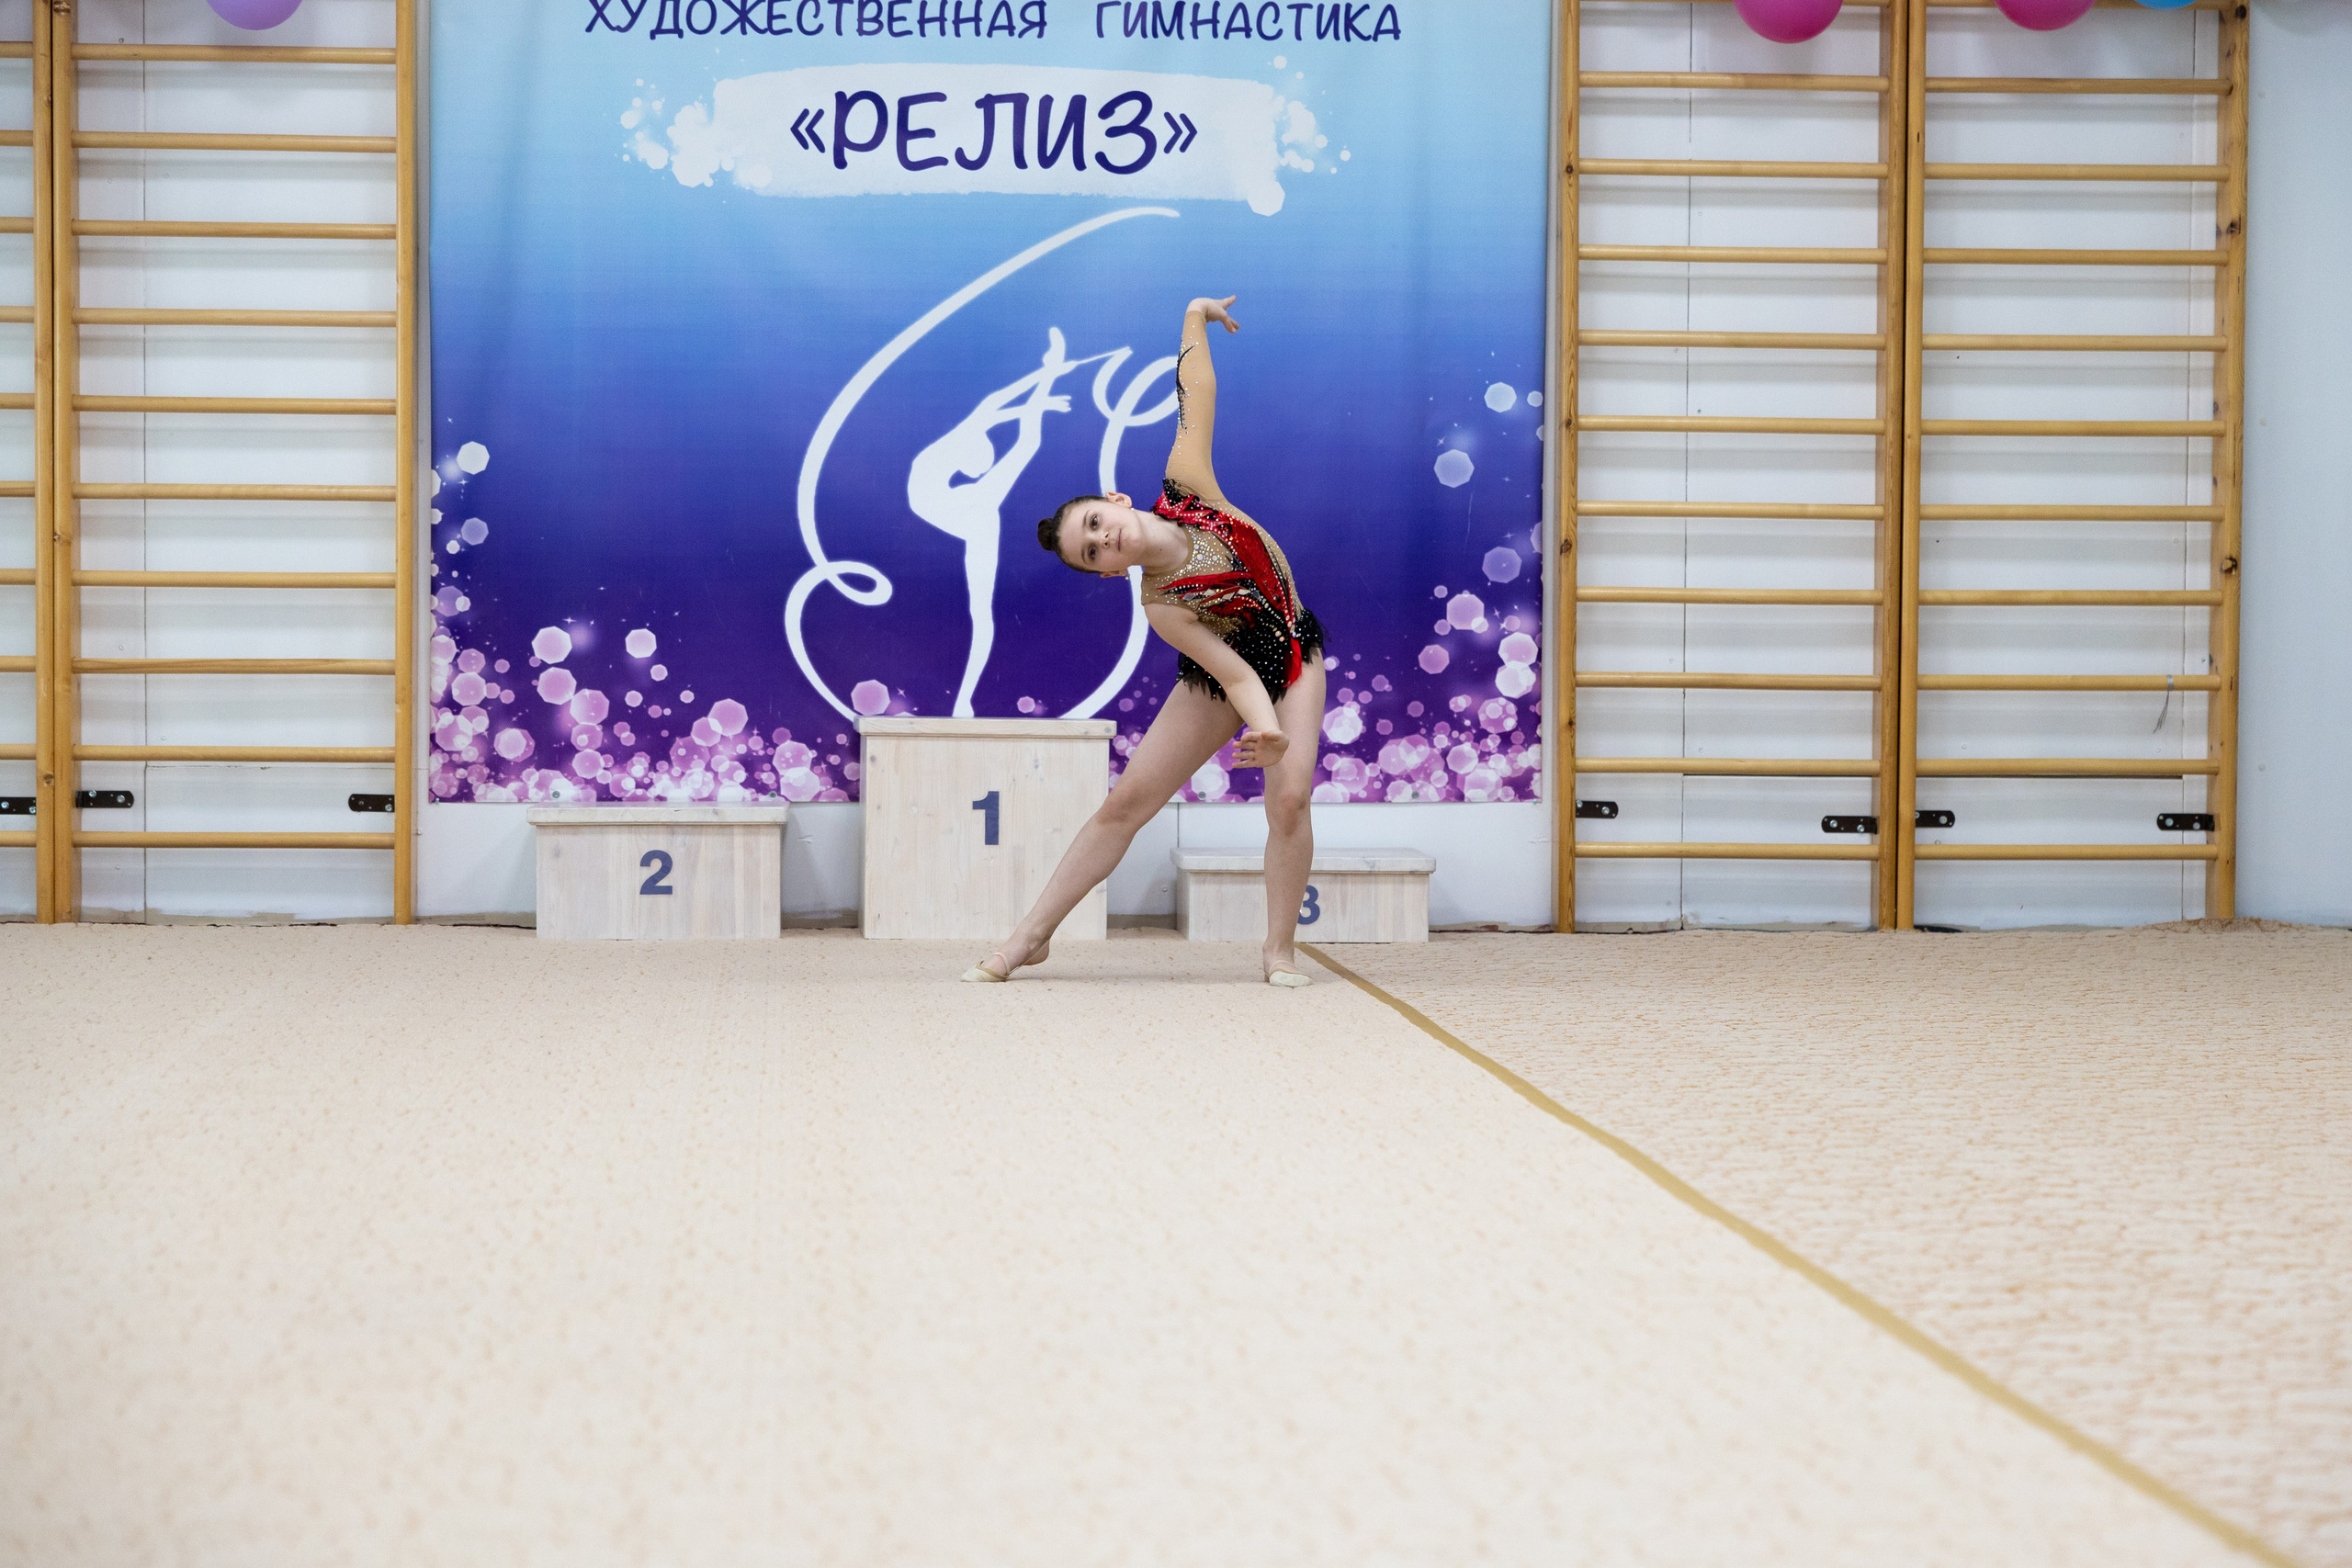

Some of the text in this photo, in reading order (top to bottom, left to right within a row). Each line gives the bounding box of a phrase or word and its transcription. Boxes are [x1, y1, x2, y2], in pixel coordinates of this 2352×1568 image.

[584, 0, 1402, 42] ХУДОЖЕСТВЕННАЯ ГИМНАСТИКА
[790, 90, 1198, 175] «РЕЛИЗ»
[972, 790, 1000, 846] 1
[639, 850, 673, 896] 2
[1296, 885, 1320, 925] 3
